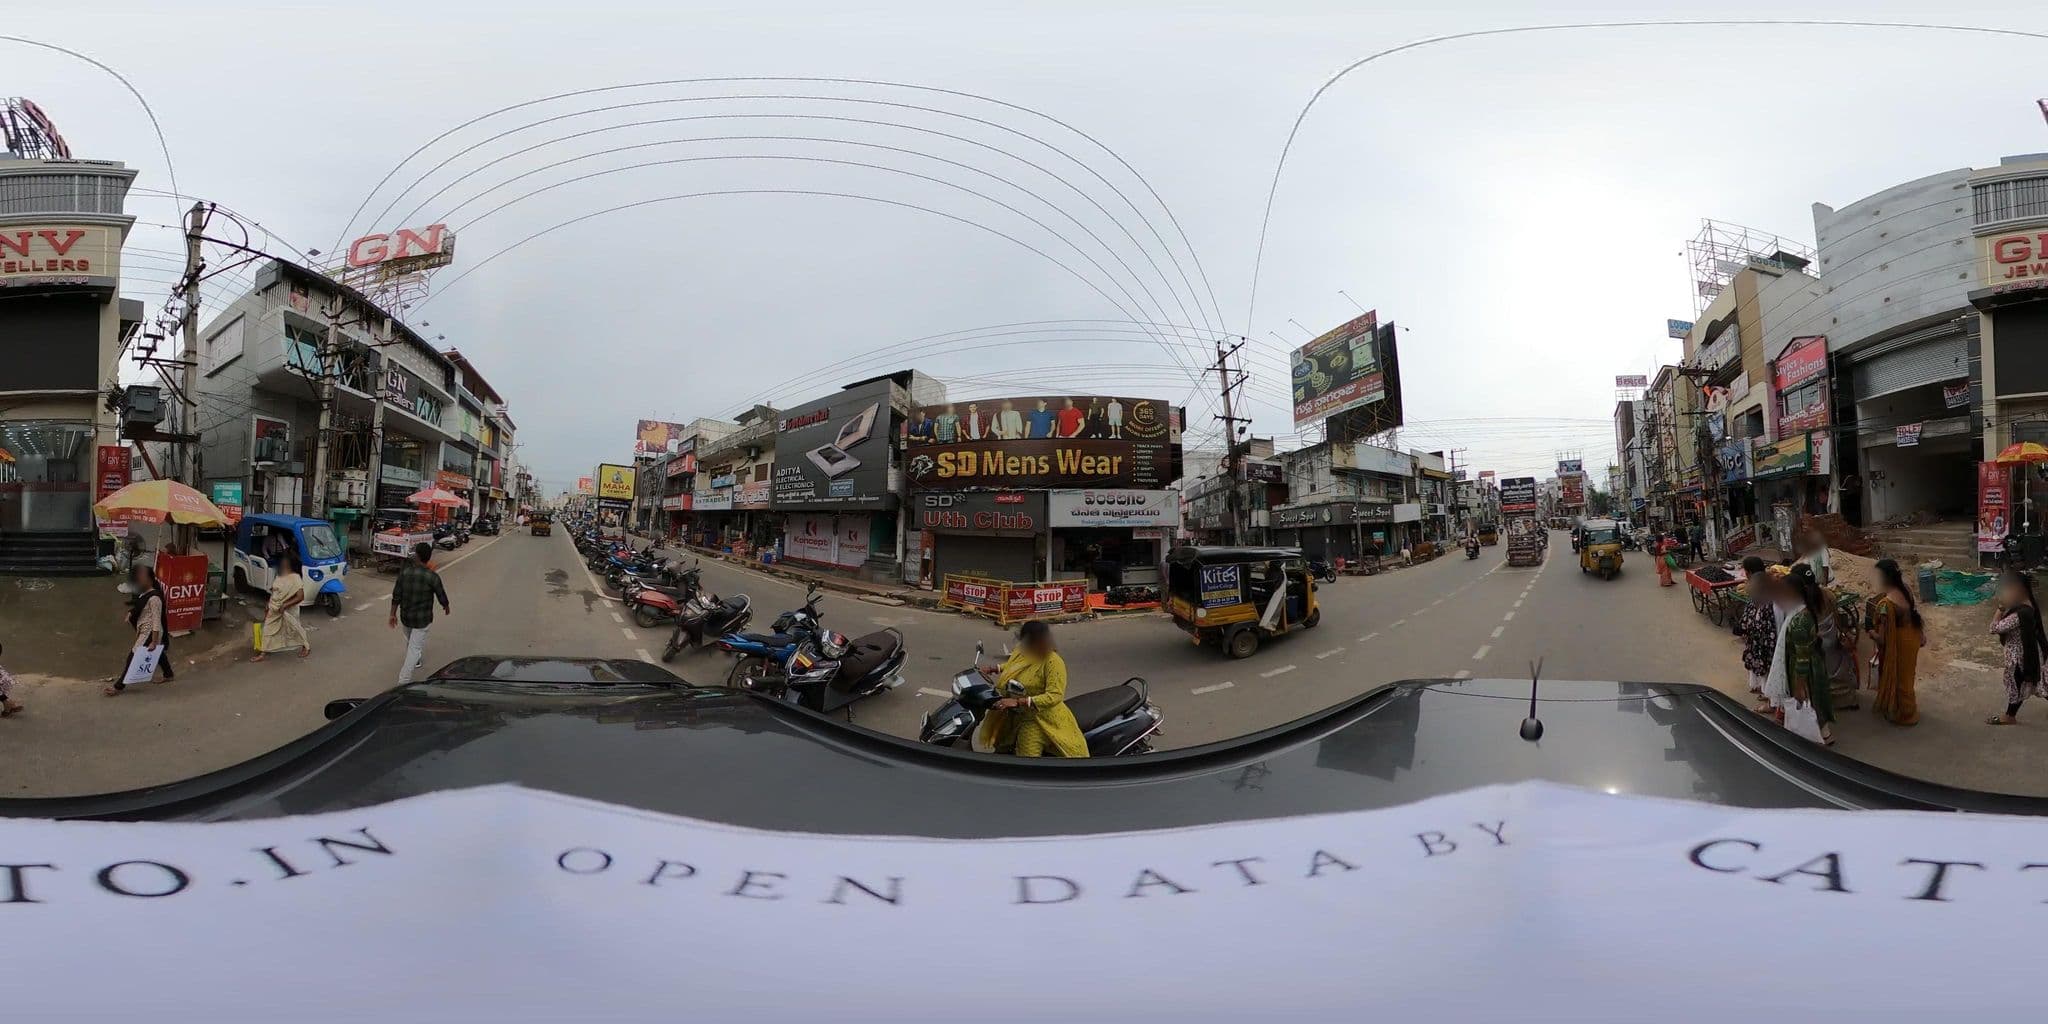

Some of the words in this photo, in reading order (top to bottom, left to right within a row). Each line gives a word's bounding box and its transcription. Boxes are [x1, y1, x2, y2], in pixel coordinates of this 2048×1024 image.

[1995, 233, 2048, 263] G
[1812, 440, 1824, 473] WINES
[937, 451, 977, 478] SD
[982, 450, 1050, 476] Mens
[1055, 449, 1122, 475] Wear
[777, 466, 801, 477] ADITYA
[776, 474, 805, 484] ELECTRICAL
[603, 482, 631, 491] MAHA
[925, 495, 953, 507] SD
[924, 510, 967, 528] Uth
[973, 511, 1033, 529] Club
[794, 536, 828, 546] Koncept
[1203, 567, 1237, 584] Kites
[170, 584, 205, 599] GNV
[965, 587, 985, 597] STOP
[1035, 592, 1061, 602] STOP
[556, 846, 906, 907] OPEN
[1013, 848, 1359, 904] DATA
[1413, 820, 1513, 858] BY
